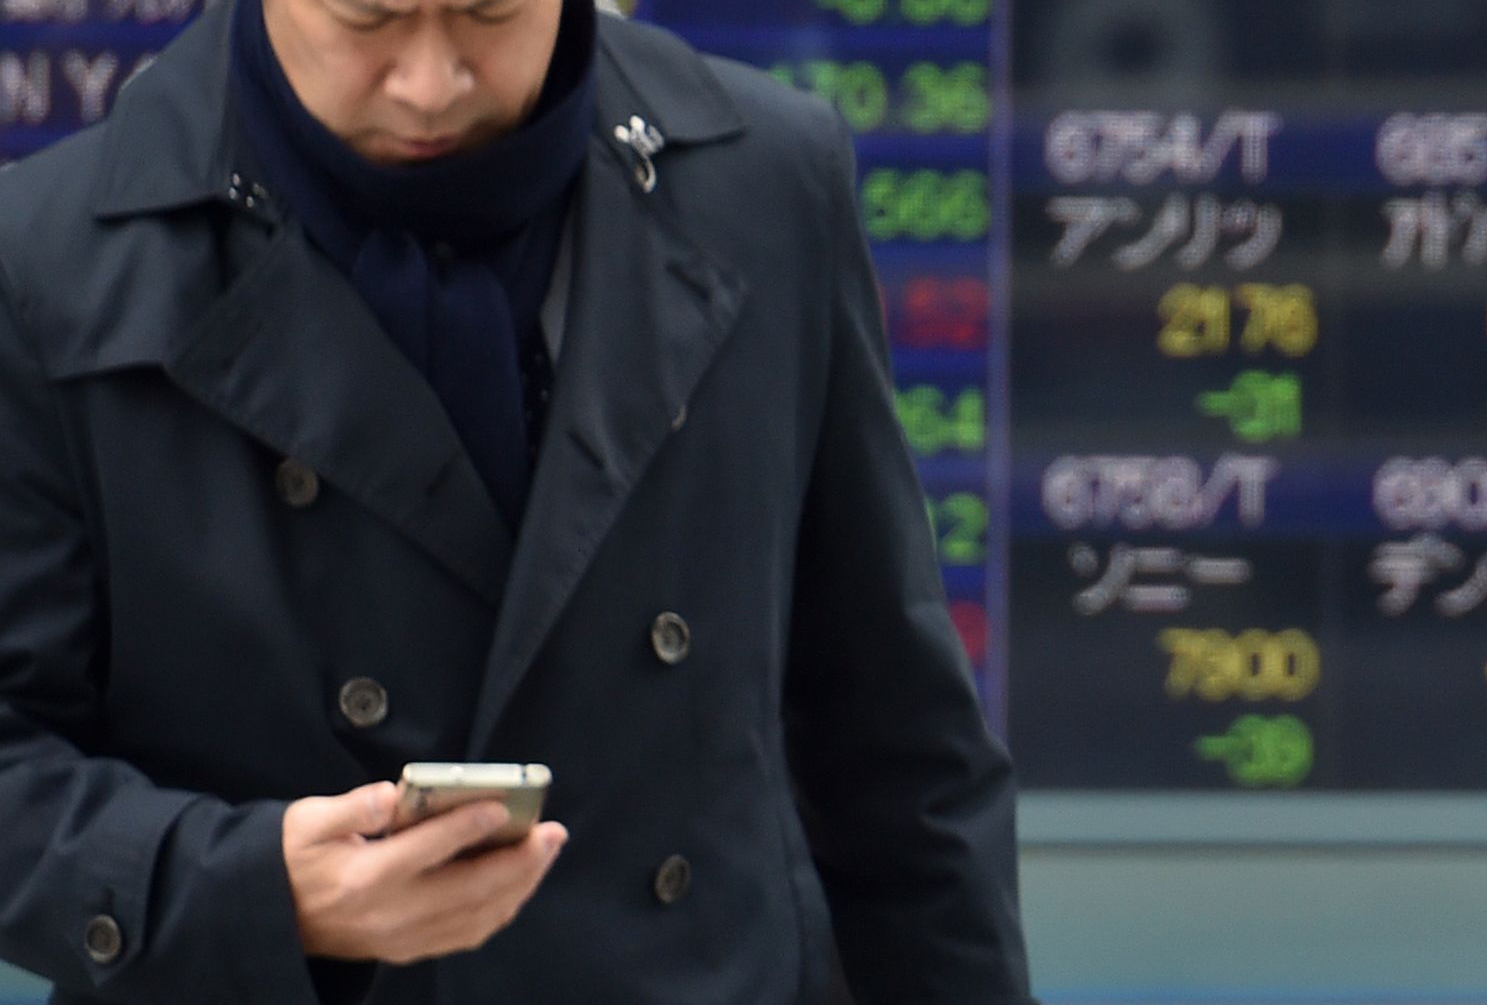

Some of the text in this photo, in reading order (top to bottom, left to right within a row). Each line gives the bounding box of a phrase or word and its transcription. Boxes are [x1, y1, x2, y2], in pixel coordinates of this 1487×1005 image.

[1045, 106, 1278, 184] 6754/T
[1042, 452, 1277, 527] 6758/T
[1072, 545, 1249, 614] ソニー
